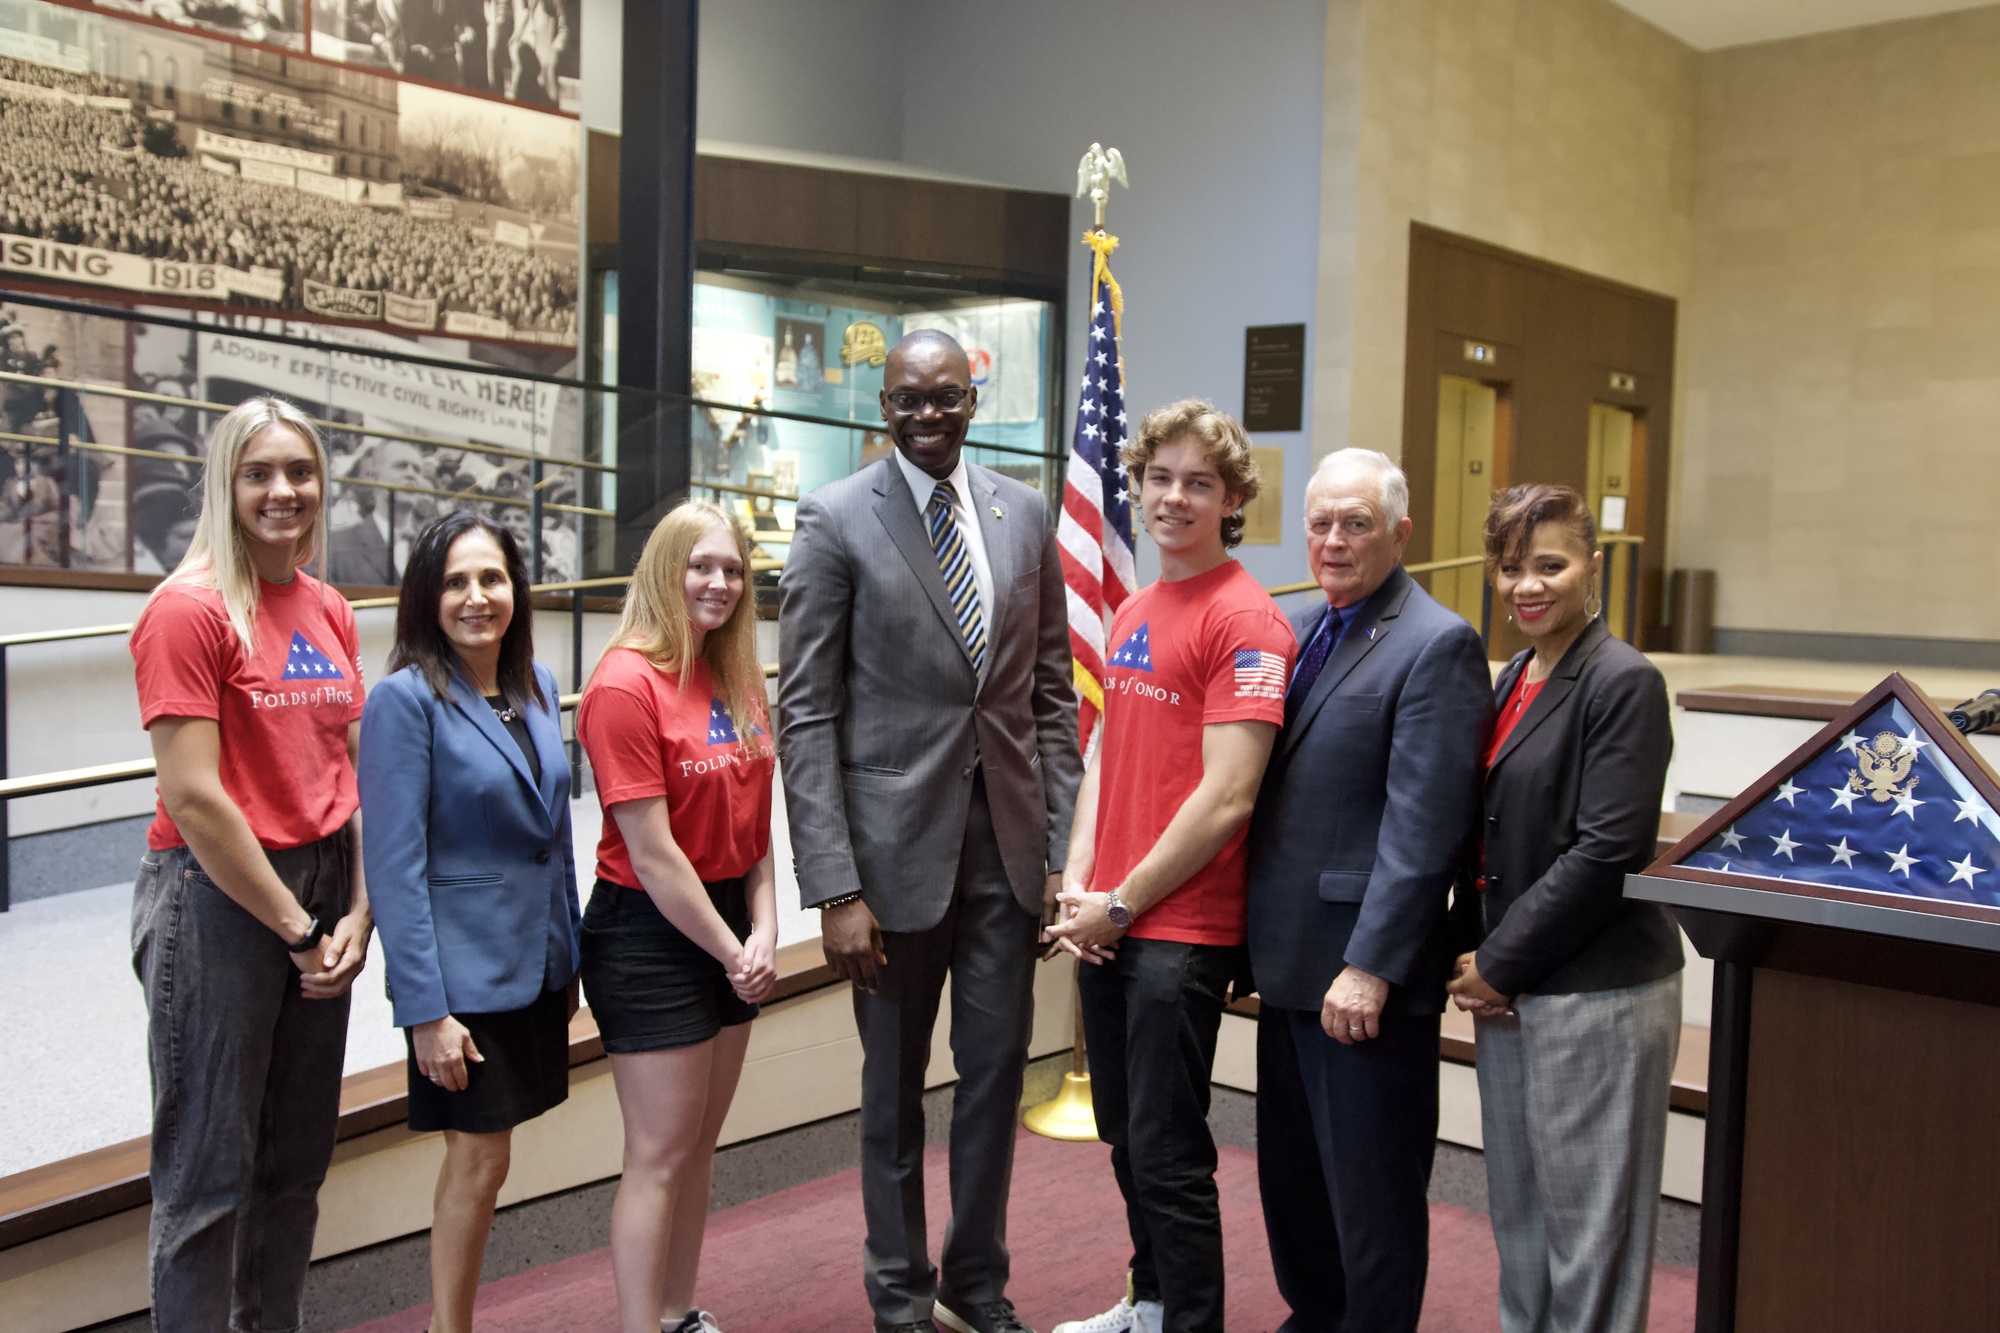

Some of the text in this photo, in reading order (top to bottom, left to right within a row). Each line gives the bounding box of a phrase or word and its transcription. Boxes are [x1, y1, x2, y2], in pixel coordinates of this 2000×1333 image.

[149, 262, 216, 290] 1916
[209, 338, 280, 369] ADOPT
[289, 359, 387, 397] EFFECTIVE
[392, 386, 431, 410] CIVIL
[437, 398, 485, 423] RIGHTS
[491, 412, 516, 428] LAW
[250, 691, 307, 708] FOLDS
[310, 687, 321, 708] of
[1119, 676, 1134, 695] of
